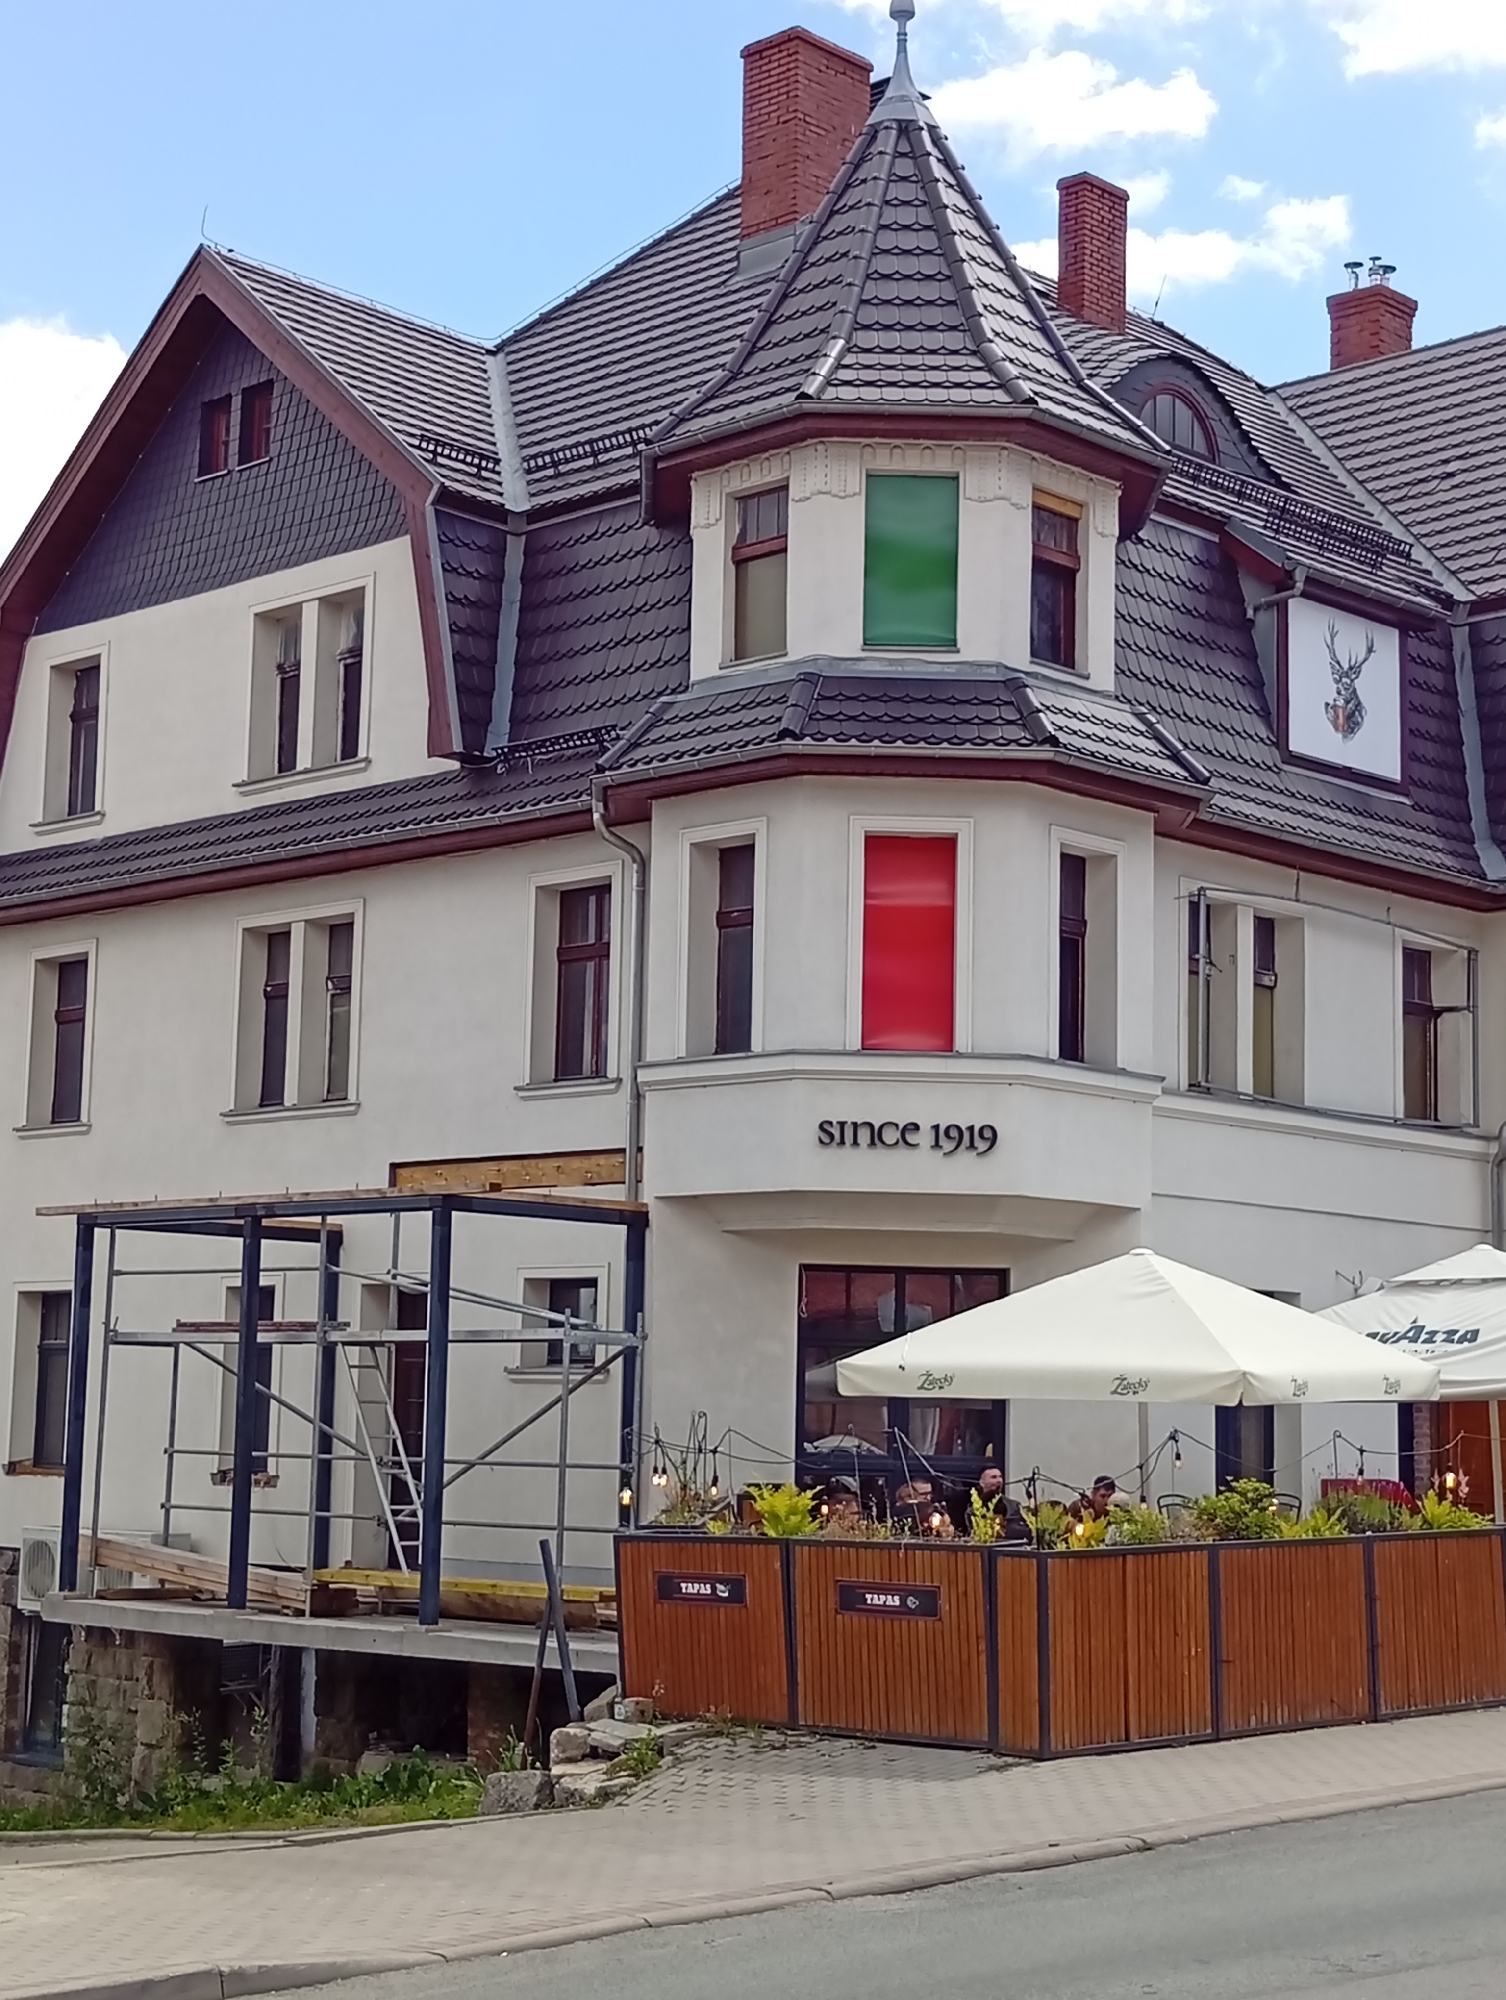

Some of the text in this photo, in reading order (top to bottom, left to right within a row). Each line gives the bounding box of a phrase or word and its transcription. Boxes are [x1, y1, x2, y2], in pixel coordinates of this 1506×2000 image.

[930, 1123, 998, 1156] 1919
[680, 1582, 712, 1595] TAPAS
[865, 1593, 901, 1607] TAPAS
